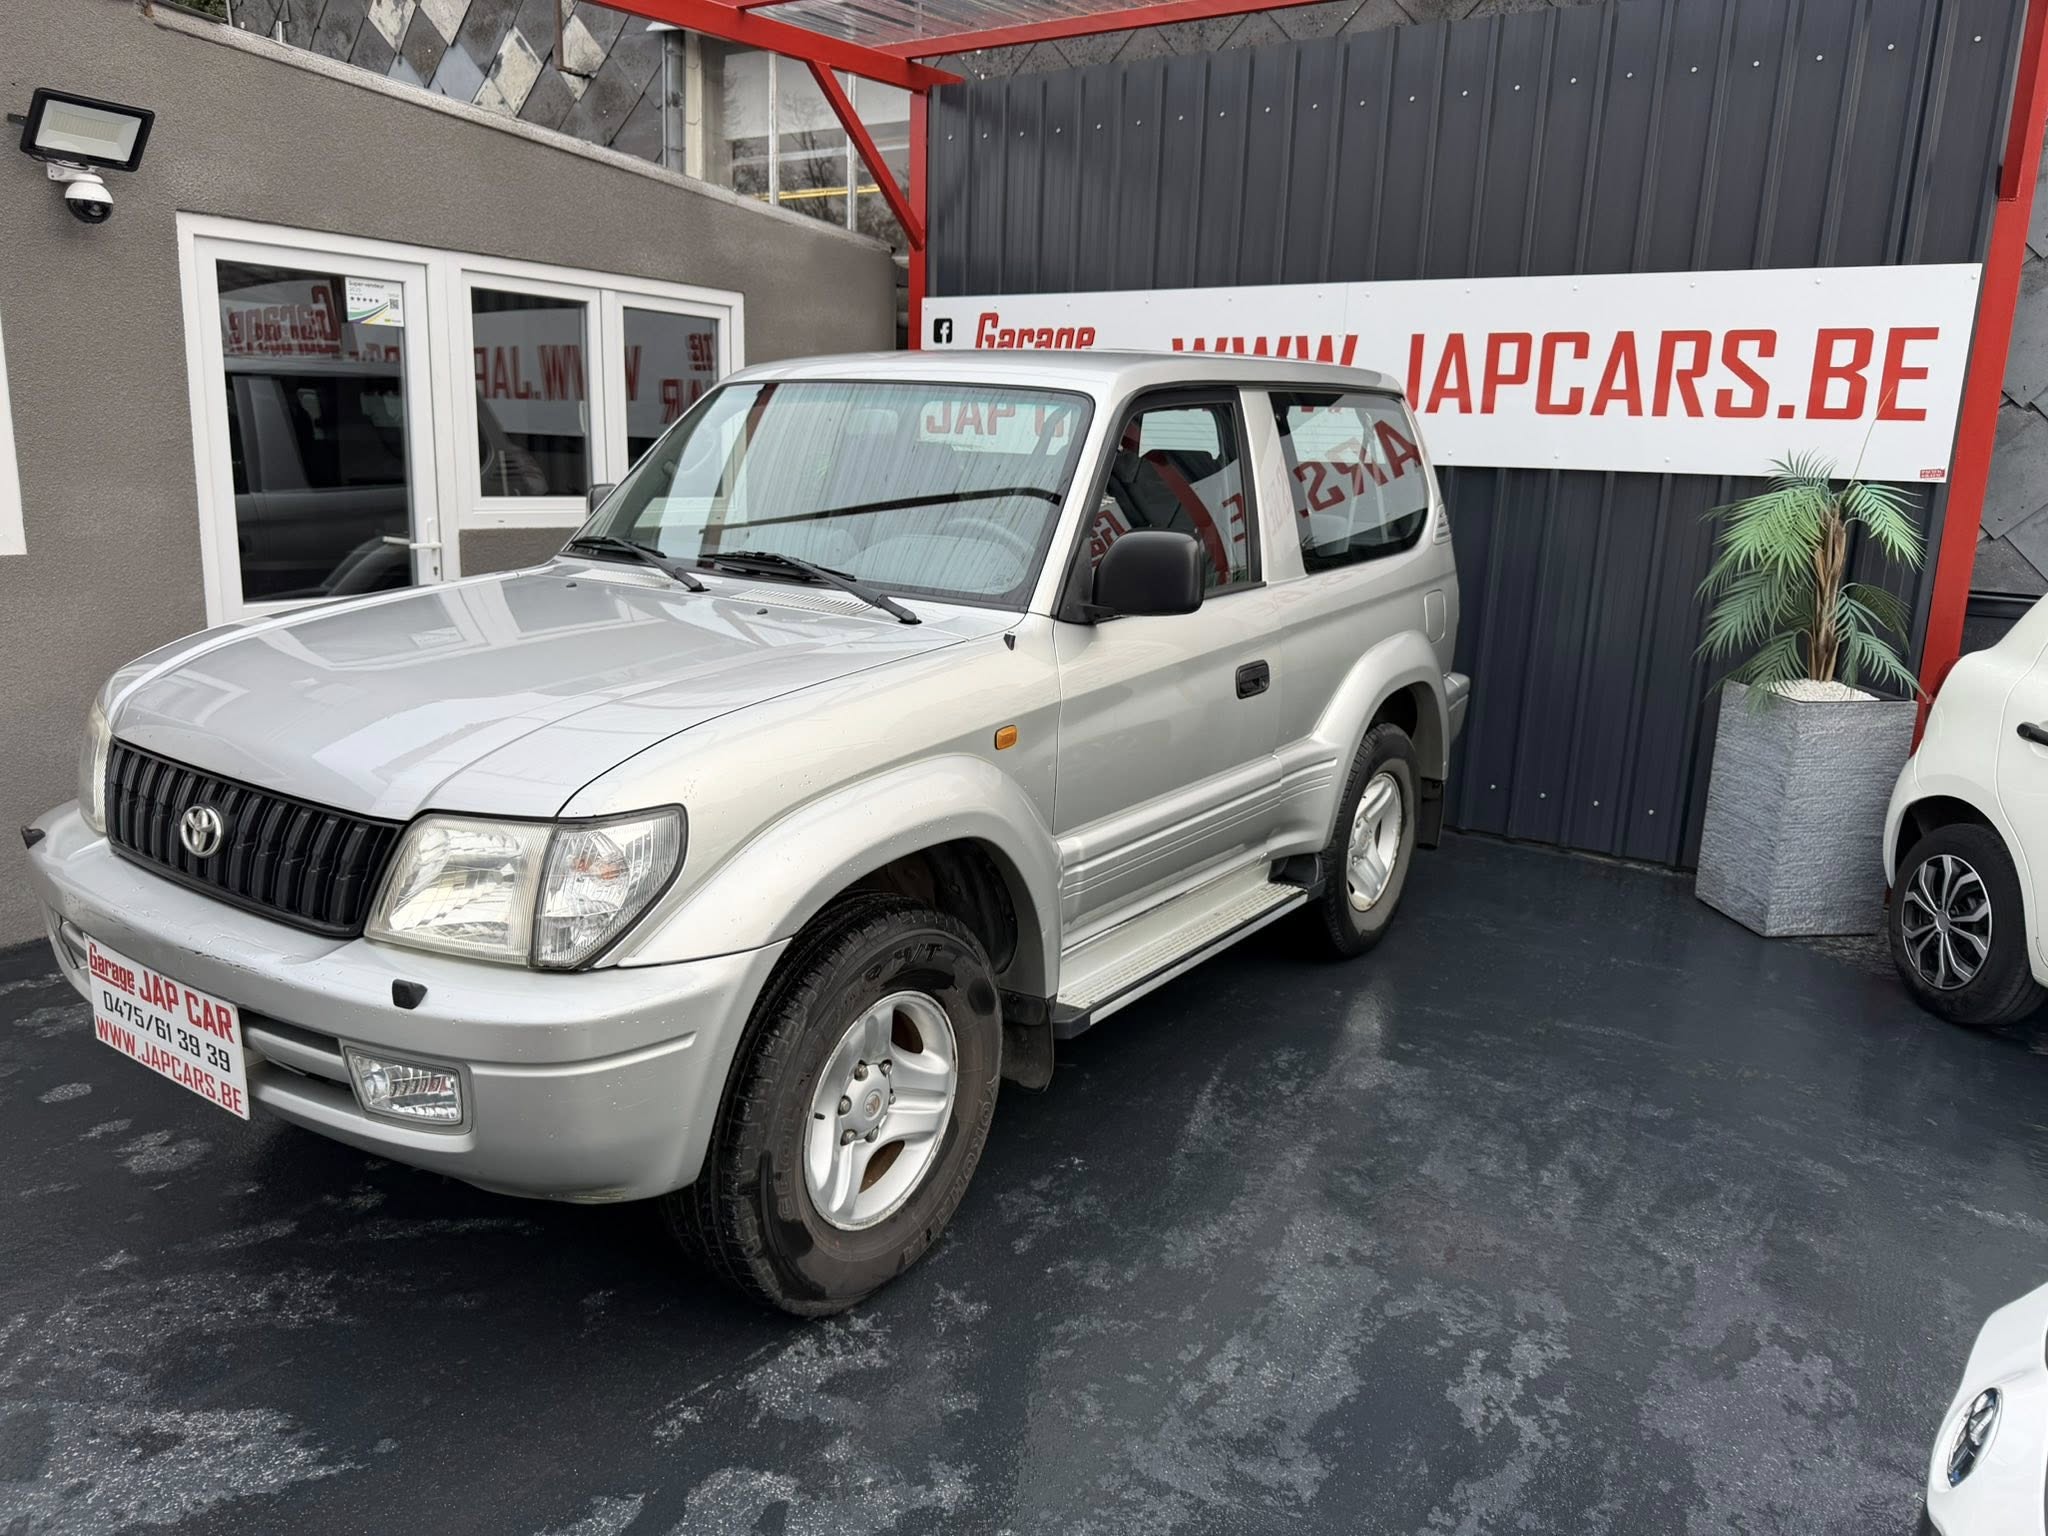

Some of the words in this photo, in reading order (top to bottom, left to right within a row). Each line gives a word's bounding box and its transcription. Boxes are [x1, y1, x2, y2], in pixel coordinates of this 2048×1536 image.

[1172, 327, 1940, 421] JAPCARS.BE
[89, 943, 135, 994] Garage
[139, 970, 180, 1014] JAP
[184, 990, 235, 1044] CAR
[103, 990, 173, 1044] 0475/61
[177, 1028, 201, 1058] 39
[206, 1042, 231, 1073] 39
[96, 1015, 244, 1115] WWW.JAPCARS.BE
